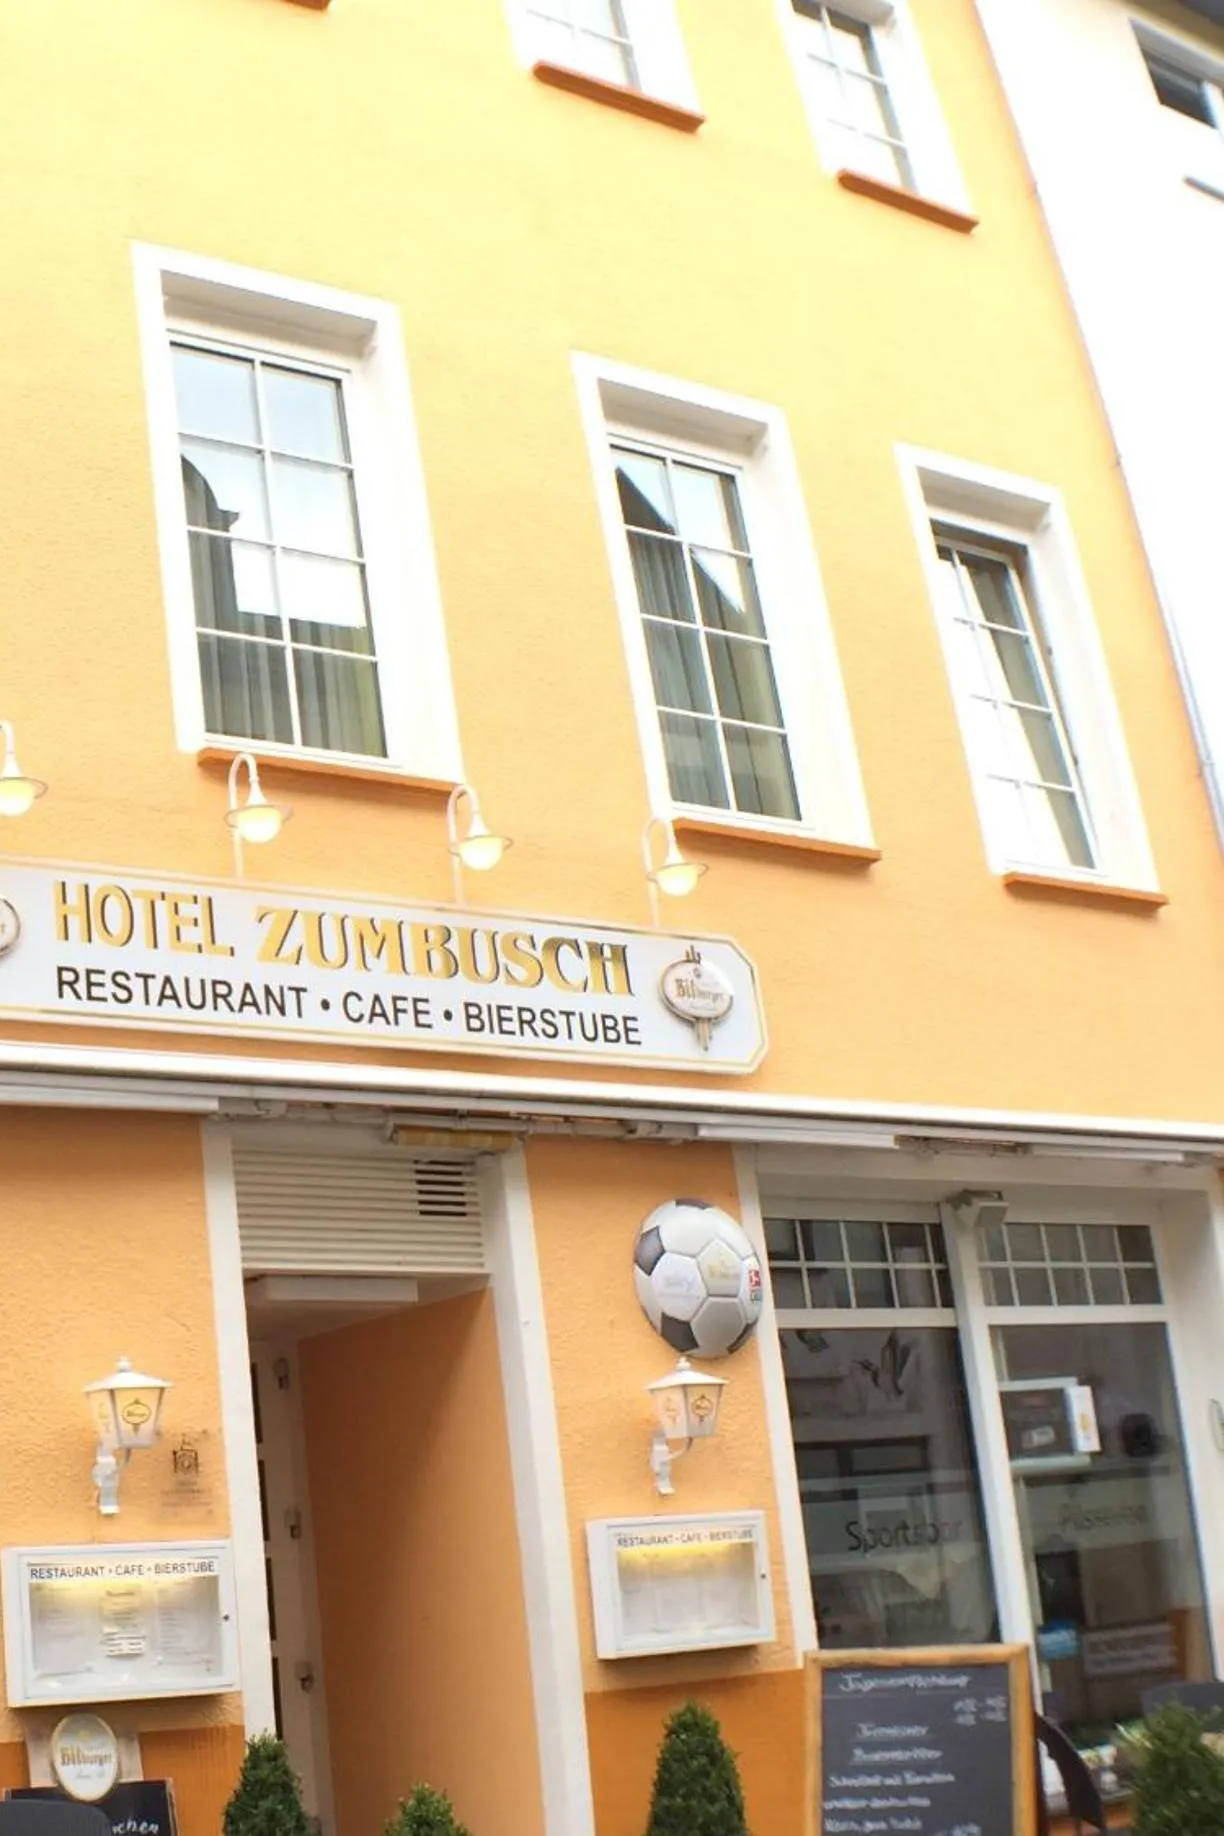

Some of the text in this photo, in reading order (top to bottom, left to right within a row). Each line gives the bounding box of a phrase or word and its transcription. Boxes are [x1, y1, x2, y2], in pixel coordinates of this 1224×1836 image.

[53, 880, 636, 997] HOTEL ZUMBUSCH
[56, 965, 642, 1046] RESTAURANT CAFE BIERSTUBE
[30, 1560, 216, 1580] RESTAURANT CAFE BIERSTUBE
